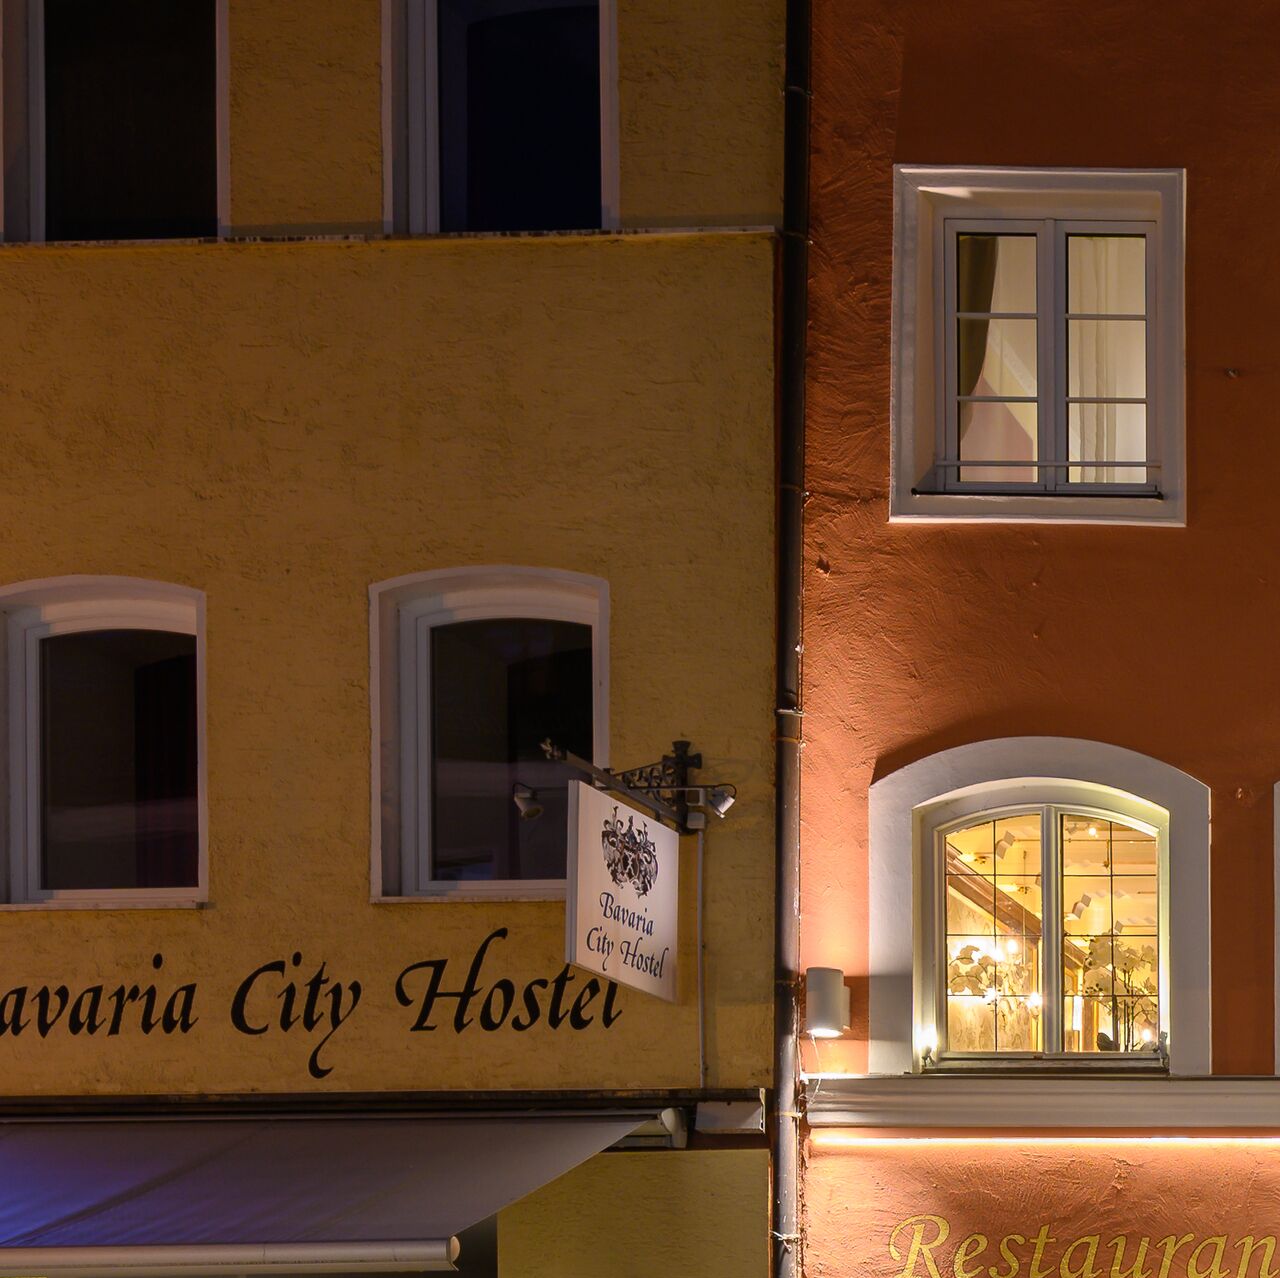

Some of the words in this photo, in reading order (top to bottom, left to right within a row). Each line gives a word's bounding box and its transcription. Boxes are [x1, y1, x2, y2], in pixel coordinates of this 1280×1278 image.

[599, 892, 654, 936] Bavaria
[586, 926, 615, 971] City
[620, 937, 669, 979] Hostel
[231, 951, 362, 1079] City
